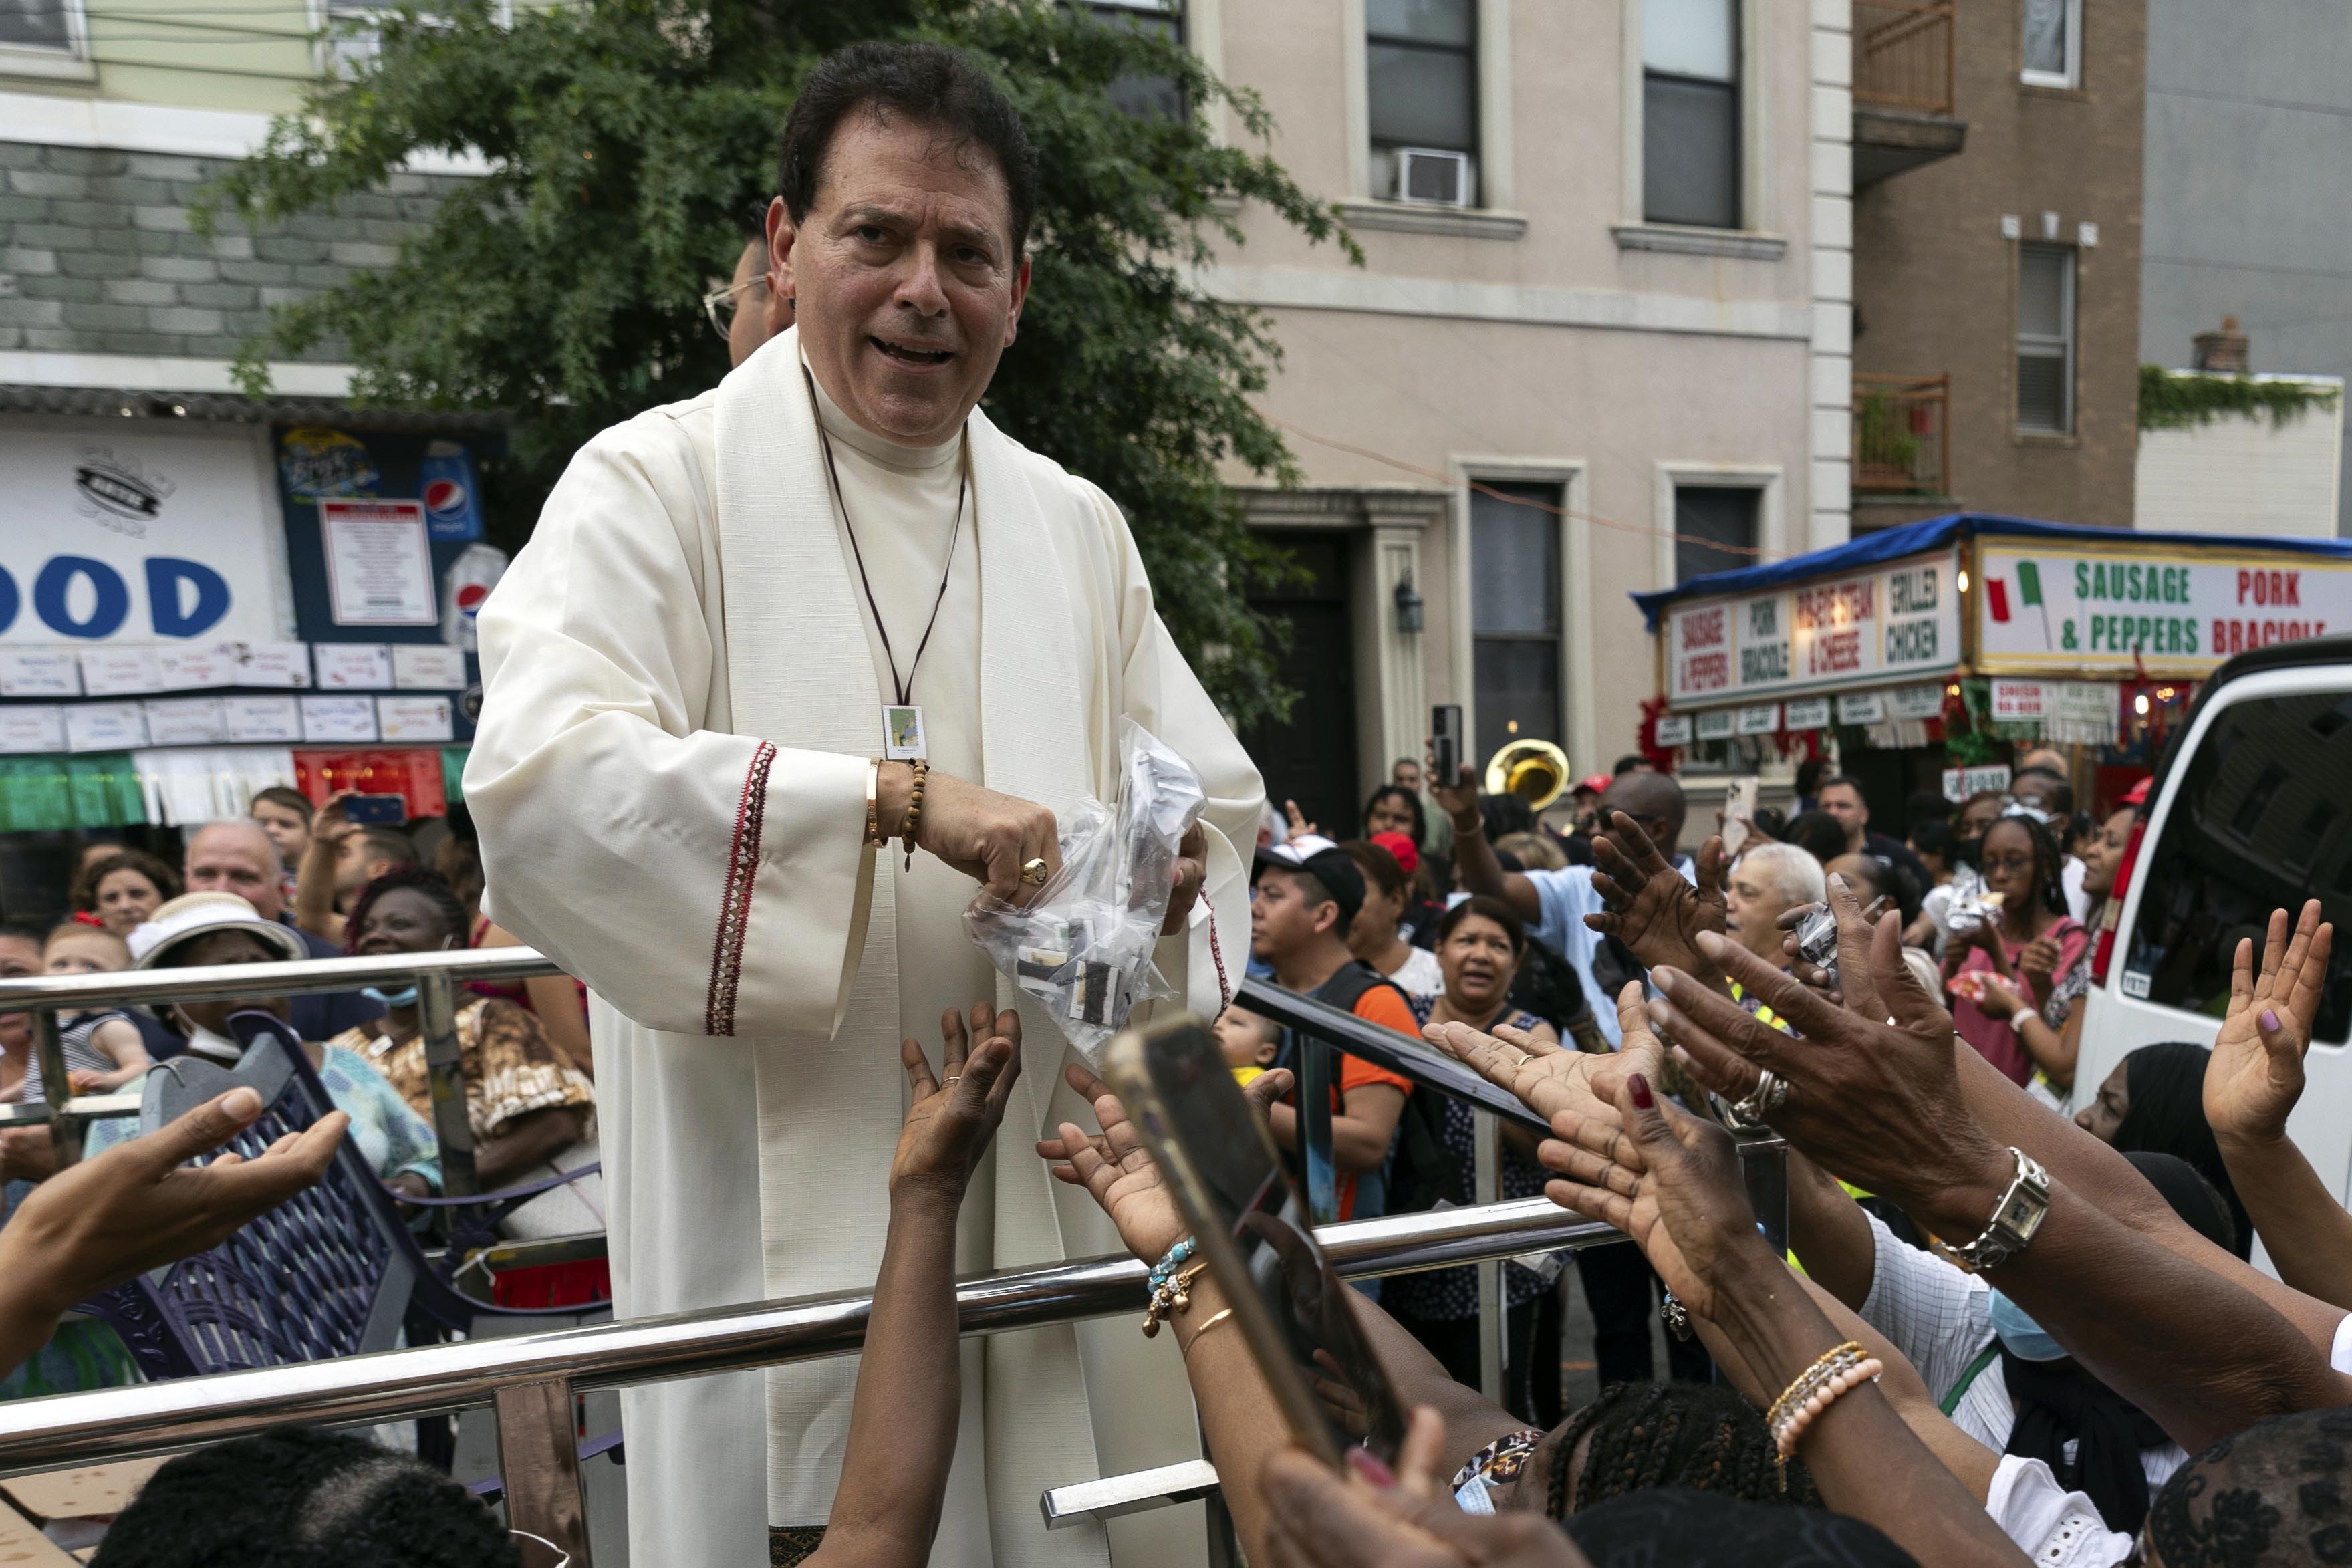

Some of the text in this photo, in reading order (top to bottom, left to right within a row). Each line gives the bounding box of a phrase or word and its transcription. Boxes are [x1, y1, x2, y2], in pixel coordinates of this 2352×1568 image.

[0, 555, 231, 640] OD
[1890, 568, 1937, 617] GRILLED
[2075, 561, 2191, 604] SAUSAGE
[2238, 571, 2300, 607] PORK
[1681, 608, 1724, 652] SAUSAGE
[1749, 598, 1779, 638] PORK
[2062, 615, 2199, 654] & PEPPERS
[1819, 630, 1860, 674] CHEESE
[1887, 618, 1938, 665] CHICKEN
